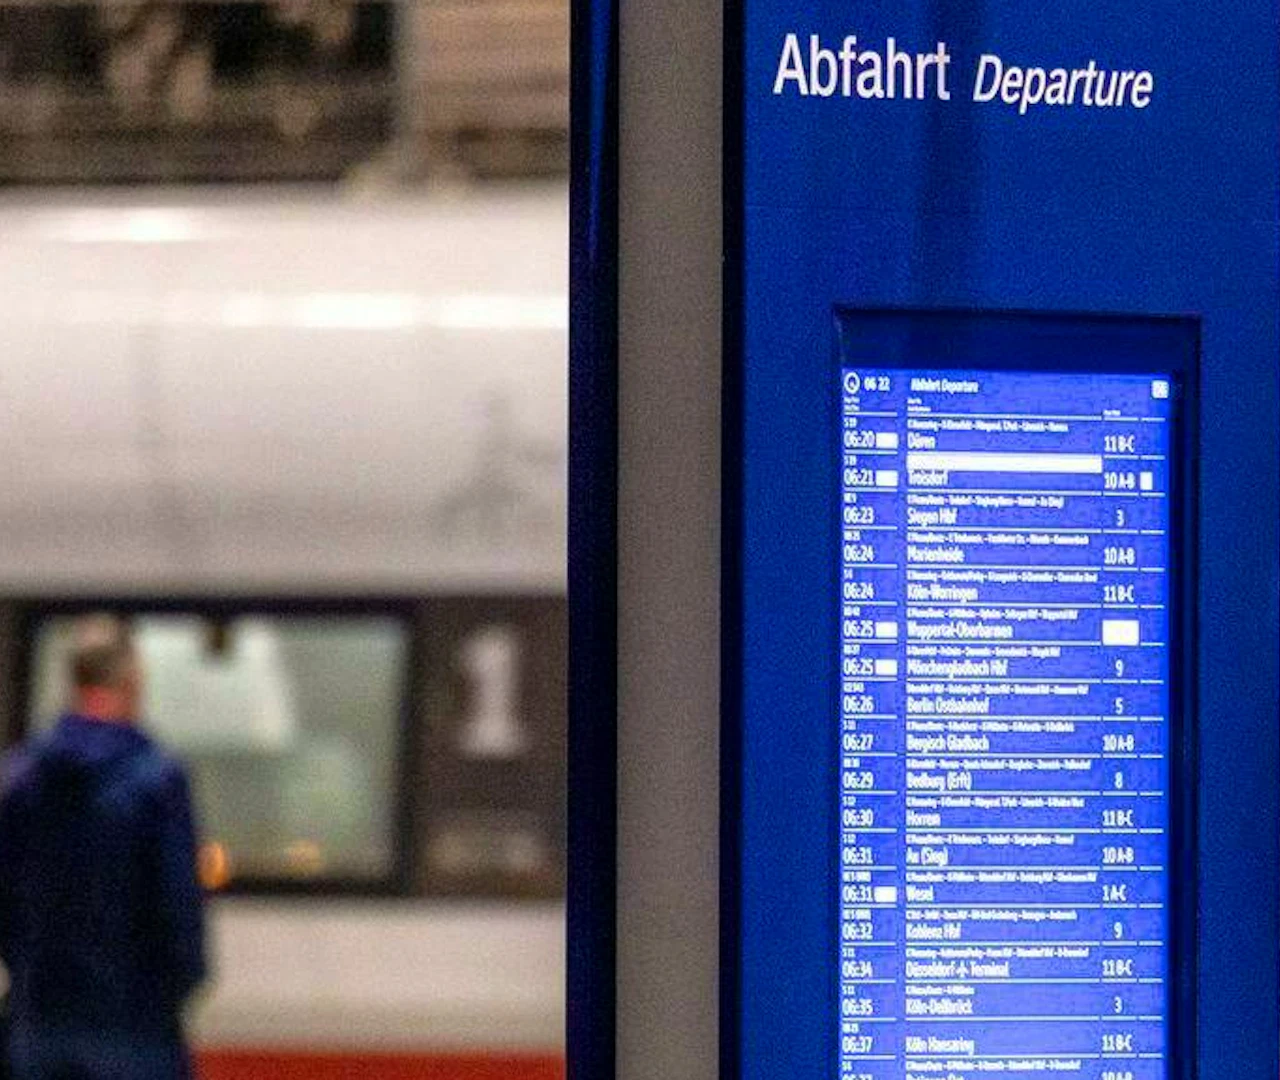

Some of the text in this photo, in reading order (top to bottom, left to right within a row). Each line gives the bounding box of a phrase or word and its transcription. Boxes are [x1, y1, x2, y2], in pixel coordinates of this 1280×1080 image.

[772, 32, 1153, 114] Abfahrt Departure
[1116, 509, 1124, 527] 3
[1115, 659, 1123, 676] 9
[459, 628, 525, 757] 1
[1115, 697, 1123, 714] 5
[1114, 772, 1123, 789] 8
[1114, 922, 1123, 939] 9
[1114, 996, 1123, 1013] 3
